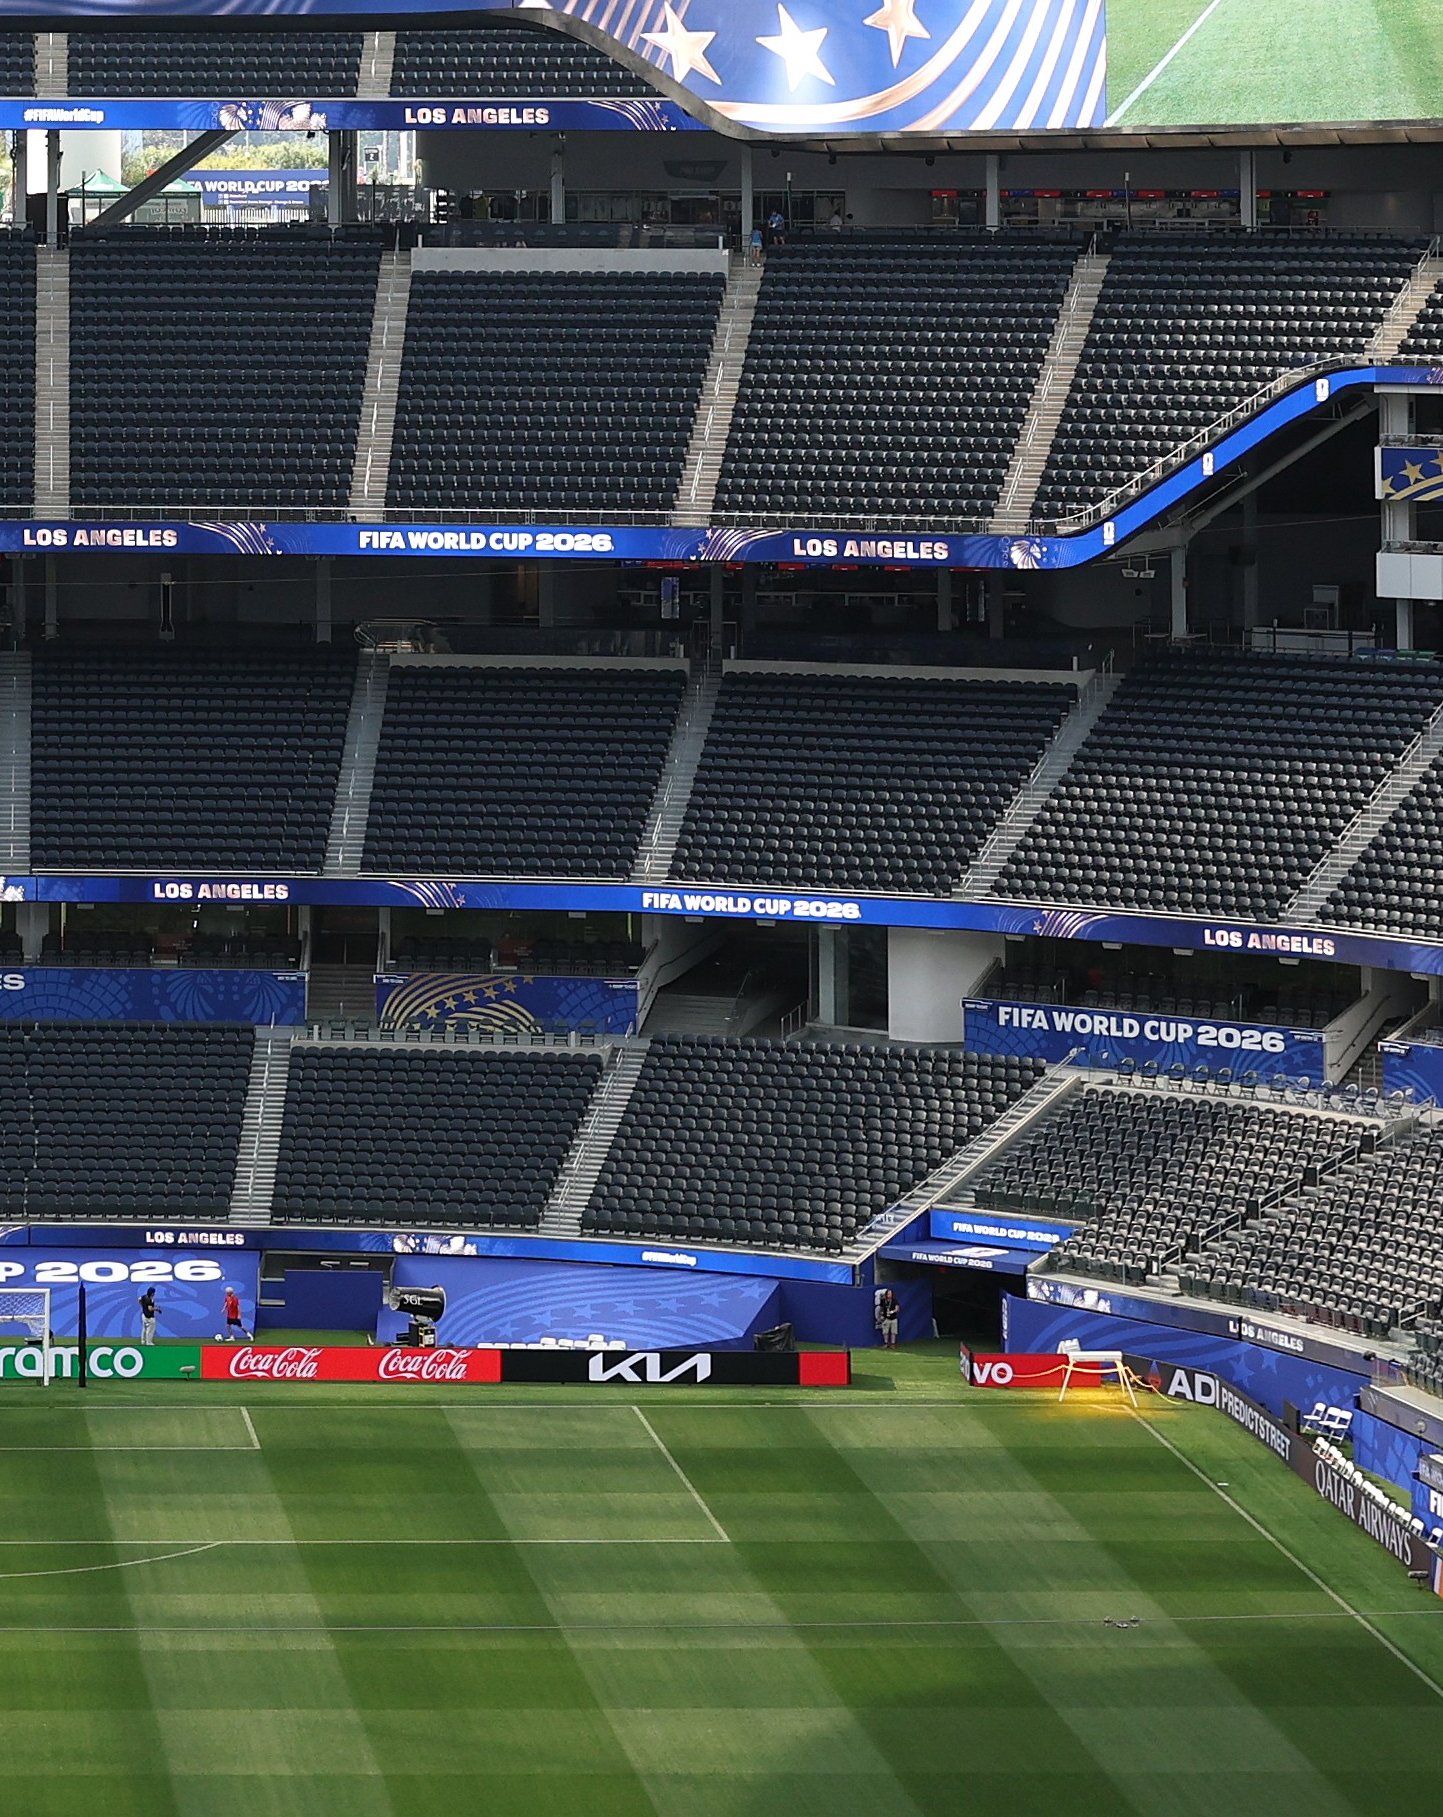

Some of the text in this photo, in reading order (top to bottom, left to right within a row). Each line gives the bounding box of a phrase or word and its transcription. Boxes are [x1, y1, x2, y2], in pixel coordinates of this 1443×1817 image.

[404, 107, 549, 124] LOS ANGELES
[23, 528, 178, 547] LOS ANGELES
[359, 531, 612, 552] FIFA WORLD CUP 2026
[793, 538, 949, 560] LOS ANGELES
[154, 882, 289, 900] LOS ANGELES
[642, 892, 861, 919] FIFA WORLD CUP 2026
[1204, 928, 1335, 956] LOS ANGELES
[998, 1006, 1285, 1053] FIFA WORLD CUP 2026
[145, 1231, 245, 1246] LOS ANGELES
[34, 1259, 222, 1283] 2026
[403, 1293, 423, 1306] SGL
[1228, 1320, 1306, 1352] LOS ANGELES
[1221, 1388, 1291, 1461] PREDICTSTREET
[1315, 1460, 1412, 1566] QATAR AIRWAYS
